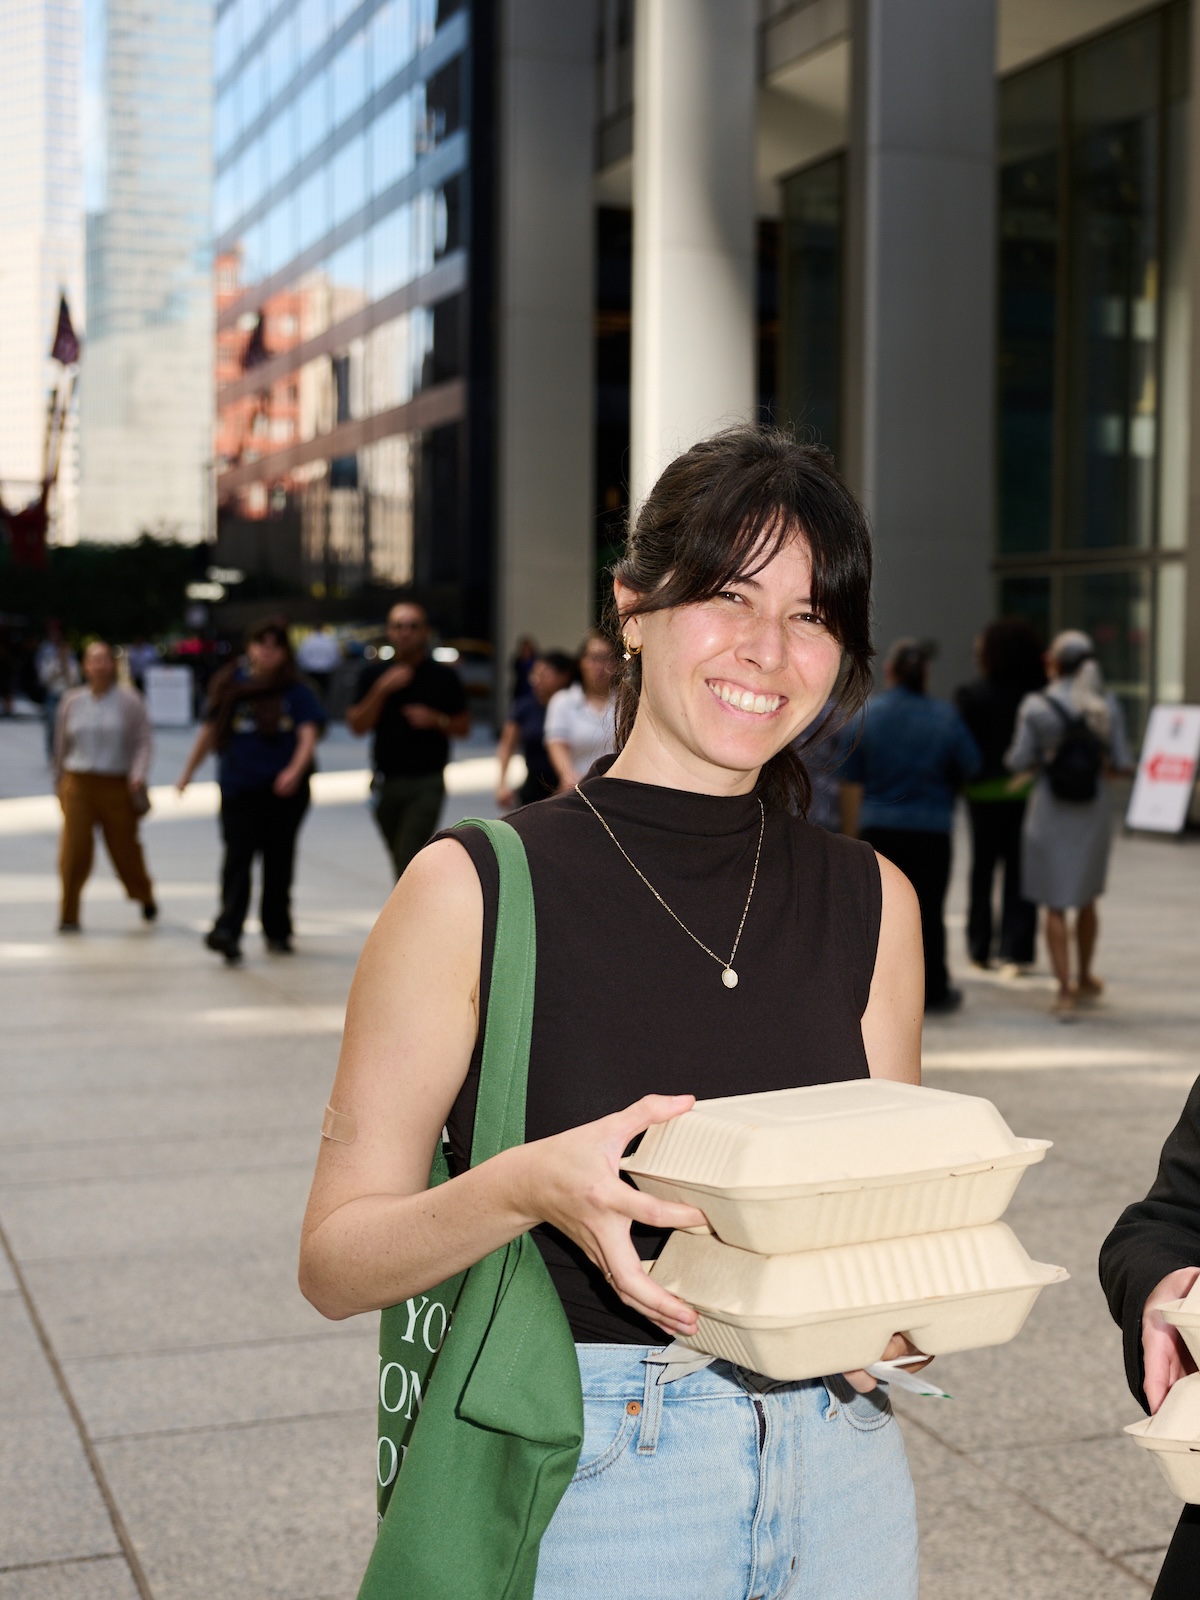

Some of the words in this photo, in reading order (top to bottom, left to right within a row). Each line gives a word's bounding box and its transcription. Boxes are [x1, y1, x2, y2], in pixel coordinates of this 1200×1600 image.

[401, 1296, 452, 1354] YO
[379, 1354, 430, 1420] ON
[377, 1437, 408, 1488] O
